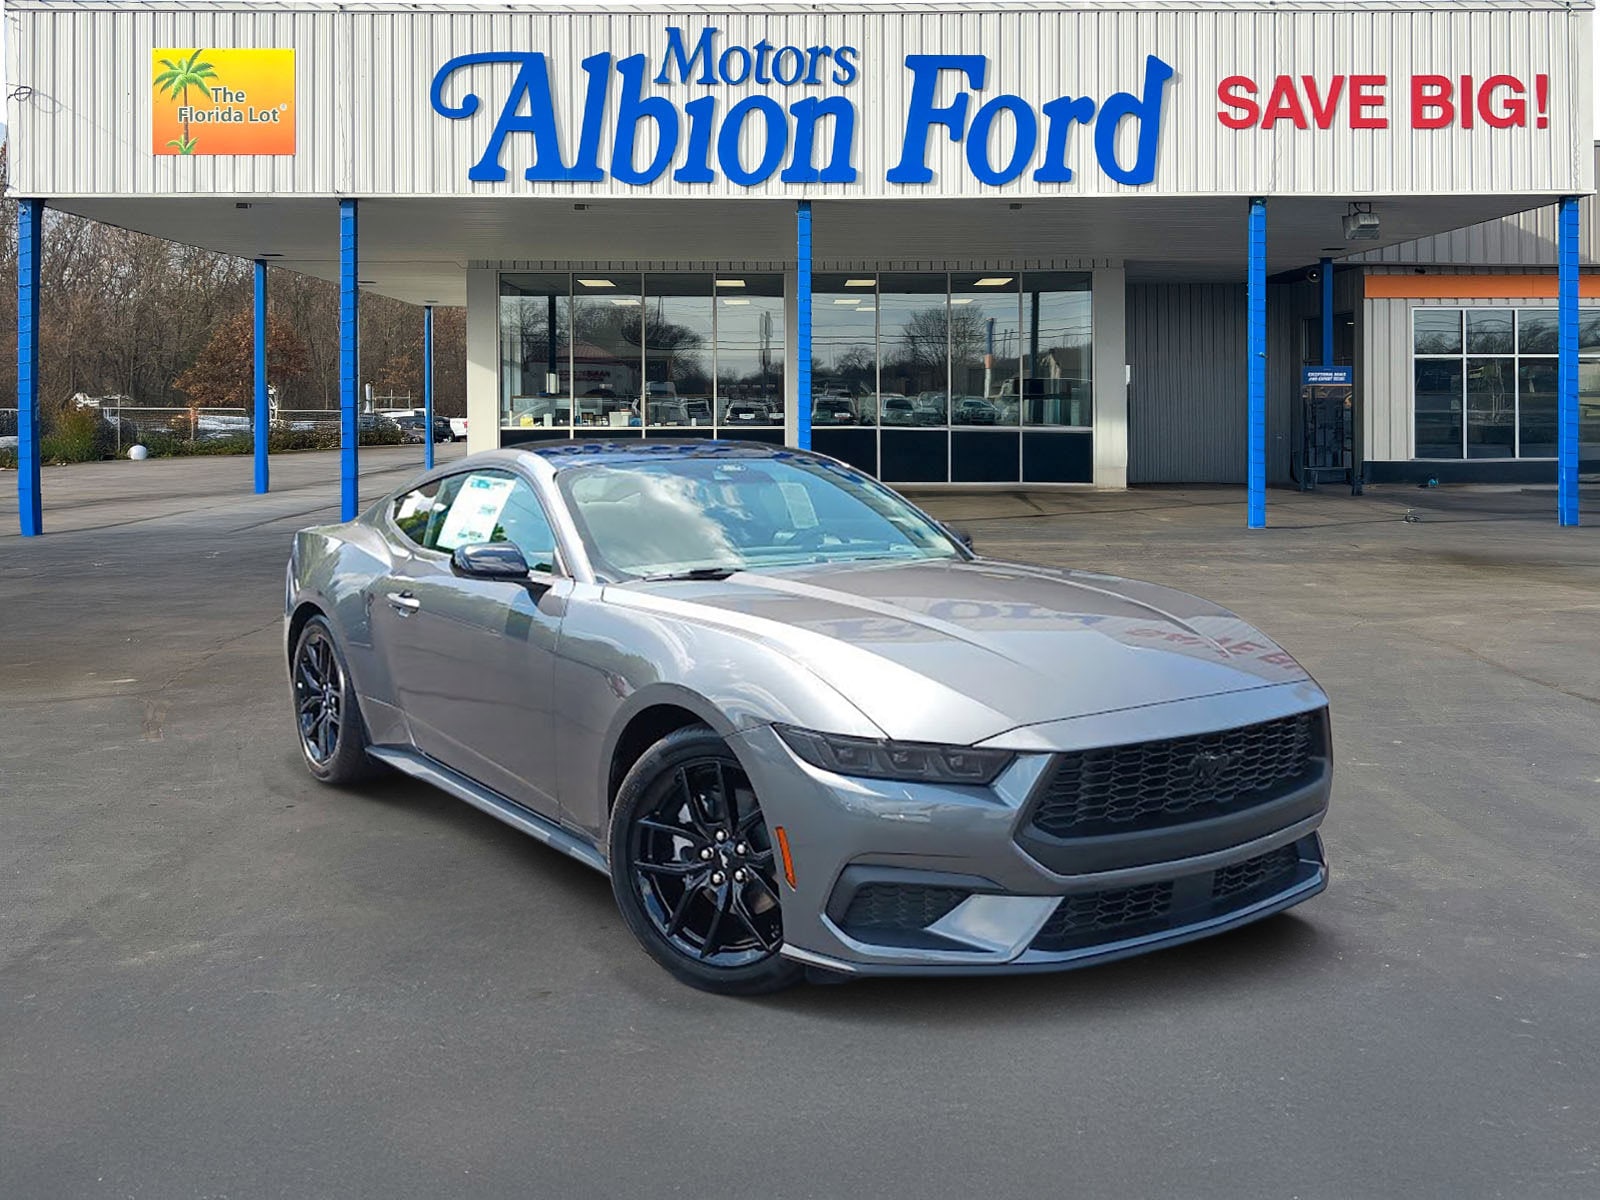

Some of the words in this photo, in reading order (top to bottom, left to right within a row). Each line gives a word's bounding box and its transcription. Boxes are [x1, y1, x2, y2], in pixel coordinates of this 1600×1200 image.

[655, 27, 857, 86] Motors
[177, 106, 244, 123] Florida
[210, 86, 246, 103] The
[430, 52, 858, 185] Albion
[886, 55, 1174, 185] Ford
[1217, 75, 1388, 128] SAVE
[1411, 74, 1548, 128] BIG!
